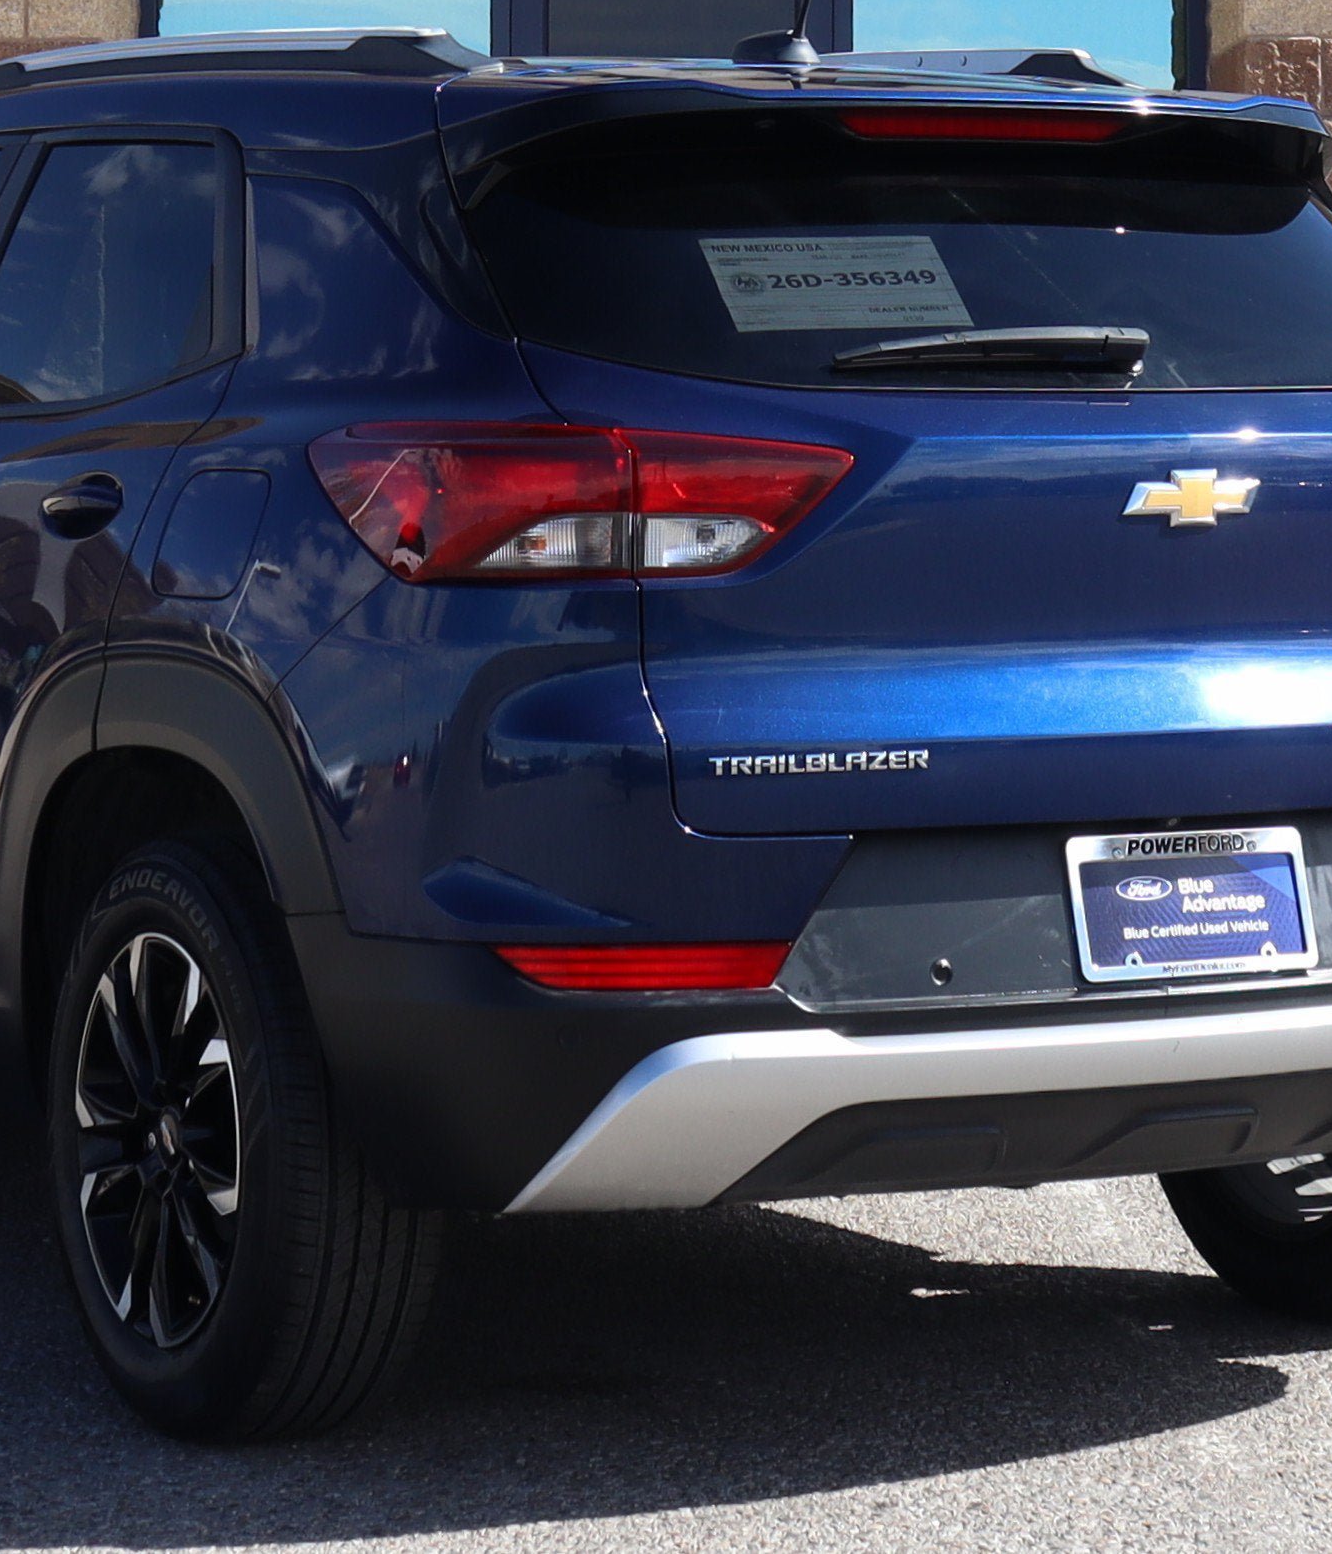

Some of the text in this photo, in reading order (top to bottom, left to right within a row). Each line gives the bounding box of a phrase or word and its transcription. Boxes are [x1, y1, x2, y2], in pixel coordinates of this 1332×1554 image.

[711, 244, 823, 254] NEW MEXICO USA
[767, 269, 937, 290] 26D-356349
[908, 304, 949, 312] NUMBER
[708, 748, 930, 776] TRAILBLAZER
[1127, 834, 1244, 855] POWERFORD
[1127, 879, 1161, 897] Ford
[1177, 878, 1213, 894] Blue
[1182, 894, 1266, 913] Advantage
[1123, 919, 1270, 940] Blue Certified Used Vehicle
